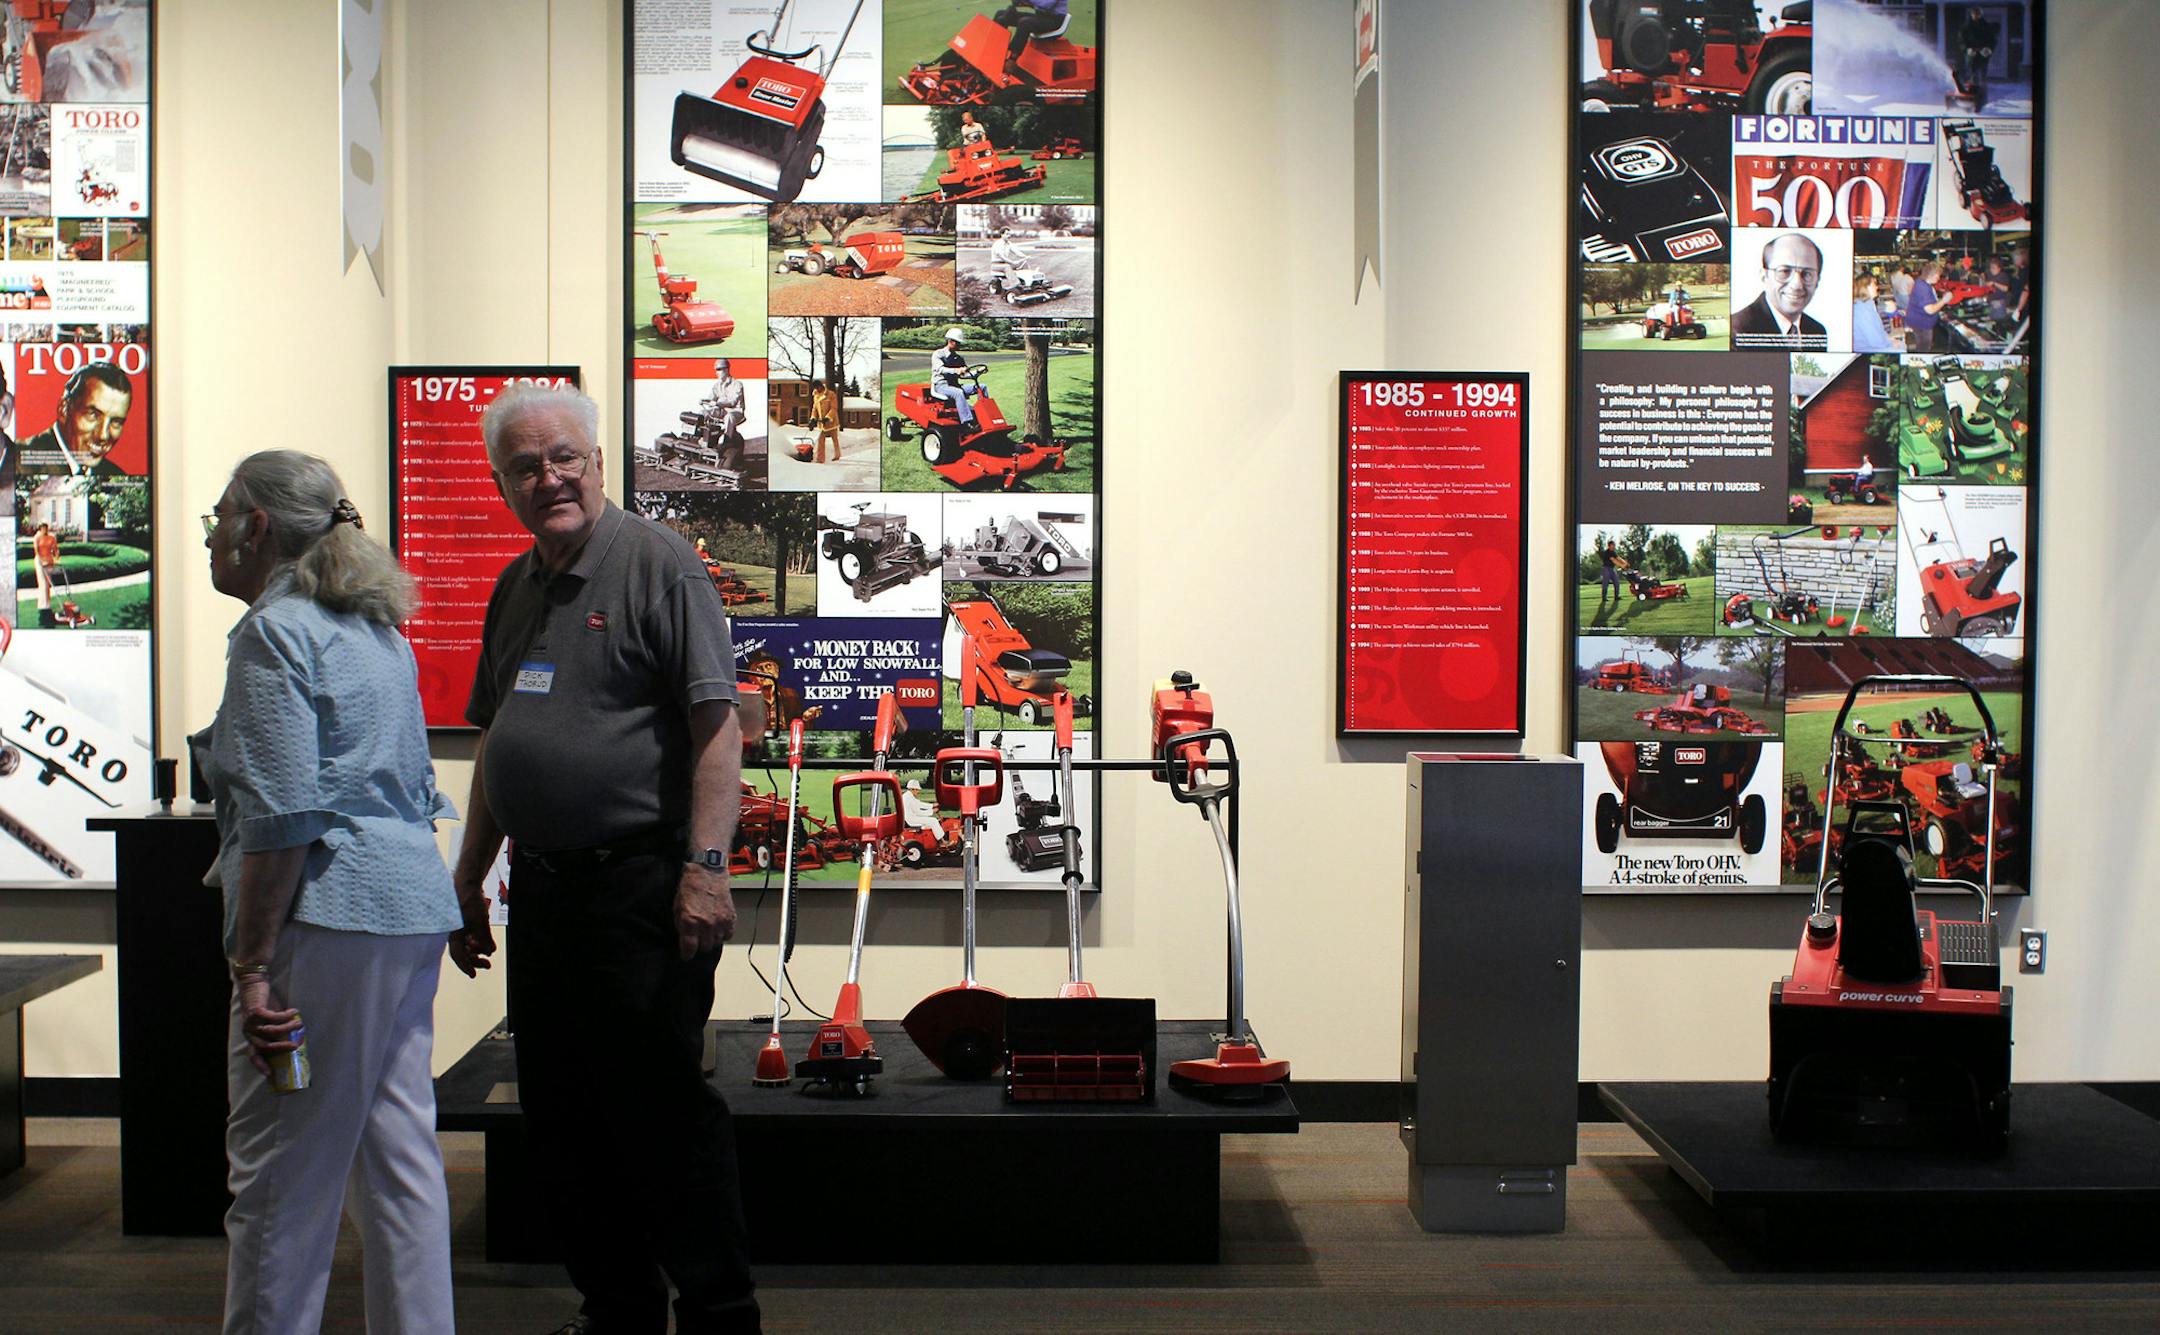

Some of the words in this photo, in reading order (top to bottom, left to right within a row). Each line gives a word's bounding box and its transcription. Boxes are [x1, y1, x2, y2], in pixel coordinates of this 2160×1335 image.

[762, 80, 792, 94] TORO
[66, 110, 140, 128] TORO
[1741, 118, 1930, 142] FORTUNE
[1620, 153, 1643, 162] OHV
[1623, 159, 1660, 172] GTS
[1752, 160, 1786, 170] THE
[1798, 162, 1884, 171] FORTUNE
[1751, 173, 1886, 228] 500
[1672, 234, 1716, 254] TORO
[20, 343, 146, 376] TORO
[410, 378, 476, 402] 1975
[1360, 382, 1425, 406] 1985
[1452, 383, 1516, 407] 1994
[1637, 384, 1653, 394] and
[1655, 384, 1688, 396] building
[1690, 386, 1697, 394] a
[1700, 385, 1727, 394] culture
[1755, 385, 1773, 395] with
[1599, 398, 1605, 406] a
[1660, 397, 1672, 408] My
[1675, 397, 1711, 408] personal
[1714, 397, 1758, 409] philosophy
[1761, 398, 1774, 407] for
[1405, 410, 1467, 418] CONTINUED
[1472, 410, 1517, 418] GROWTH
[1599, 410, 1631, 418] success
[1632, 409, 1640, 418] in
[1641, 409, 1677, 418] business
[1678, 409, 1685, 418] is
[1706, 409, 1743, 421] Everyone
[1744, 410, 1758, 419] has
[1760, 410, 1773, 419] the
[1599, 421, 1634, 432] potential
[1635, 422, 1642, 430] to
[1643, 422, 1682, 430] contribute
[1683, 422, 1690, 431] to
[1691, 422, 1729, 433] achieving
[1729, 422, 1742, 431] the
[1742, 422, 1764, 433] goals
[1765, 422, 1773, 431] of
[1599, 433, 1612, 443] the
[1659, 435, 1673, 445] you
[1674, 435, 1688, 443] can
[1689, 434, 1720, 444] unleash
[1721, 434, 1737, 444] that
[1599, 446, 1627, 455] market
[1629, 446, 1671, 457] leadership
[1672, 446, 1687, 455] and
[1689, 446, 1723, 456] financial
[1724, 448, 1756, 456] success
[1757, 447, 1772, 456] will
[1599, 458, 1610, 467] be
[1611, 458, 1639, 467] natural
[1610, 482, 1625, 490] KEN
[1626, 482, 1666, 491] MELROSE,
[1667, 482, 1679, 490] ON
[1680, 482, 1696, 491] THE
[1697, 482, 1712, 491] KEY
[1713, 482, 1724, 491] TO
[1725, 482, 1760, 491] SUCCESS
[813, 640, 871, 656] MONEY
[872, 640, 920, 656] BACK!
[794, 658, 822, 670] FOR
[827, 658, 857, 670] LOW
[819, 671, 861, 682] AND...
[804, 686, 852, 700] KEEP
[856, 686, 894, 700] THE
[899, 688, 935, 698] TORO
[20, 709, 128, 784] TORO
[1678, 752, 1702, 760] TORO
[1715, 816, 1728, 827] 21
[1616, 855, 1642, 869] The
[1644, 859, 1673, 869] new
[1674, 855, 1704, 869] Toro
[1707, 855, 1741, 870] OHV.
[1609, 870, 1621, 884] A
[1622, 870, 1680, 884] 4-stroke
[1682, 870, 1698, 884] of
[1699, 870, 1747, 886] genius.
[1840, 990, 1884, 1002] power
[1886, 994, 1924, 1003] curve
